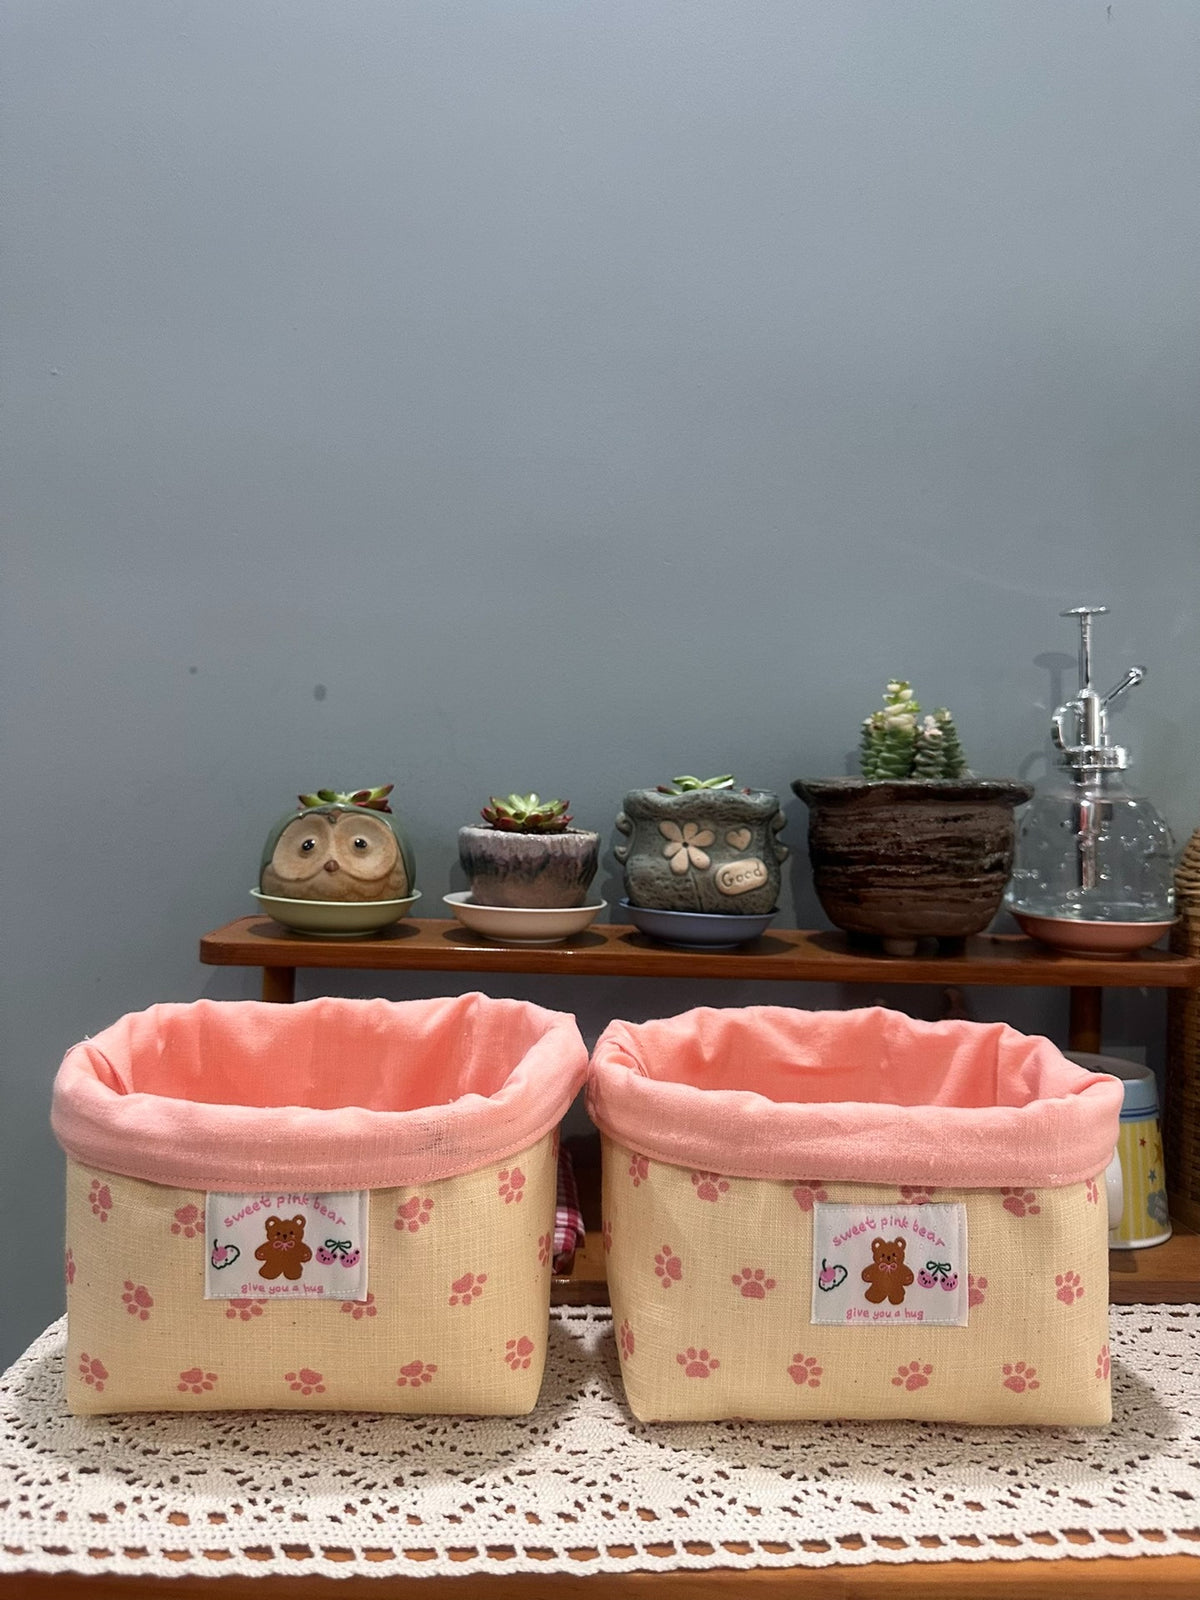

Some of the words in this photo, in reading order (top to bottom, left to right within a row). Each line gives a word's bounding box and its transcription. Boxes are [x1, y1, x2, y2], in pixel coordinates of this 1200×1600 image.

[721, 862, 763, 888] Good
[224, 1195, 272, 1228] sweet
[276, 1193, 309, 1209] pink
[313, 1197, 346, 1226] bear
[832, 1216, 876, 1247] sweet
[881, 1216, 909, 1230] pink
[913, 1219, 945, 1247] bear
[241, 1283, 265, 1294] give
[269, 1285, 289, 1294] you
[303, 1283, 324, 1294] hug
[846, 1308, 869, 1320] give
[873, 1310, 892, 1320] you
[905, 1308, 924, 1320] hug
